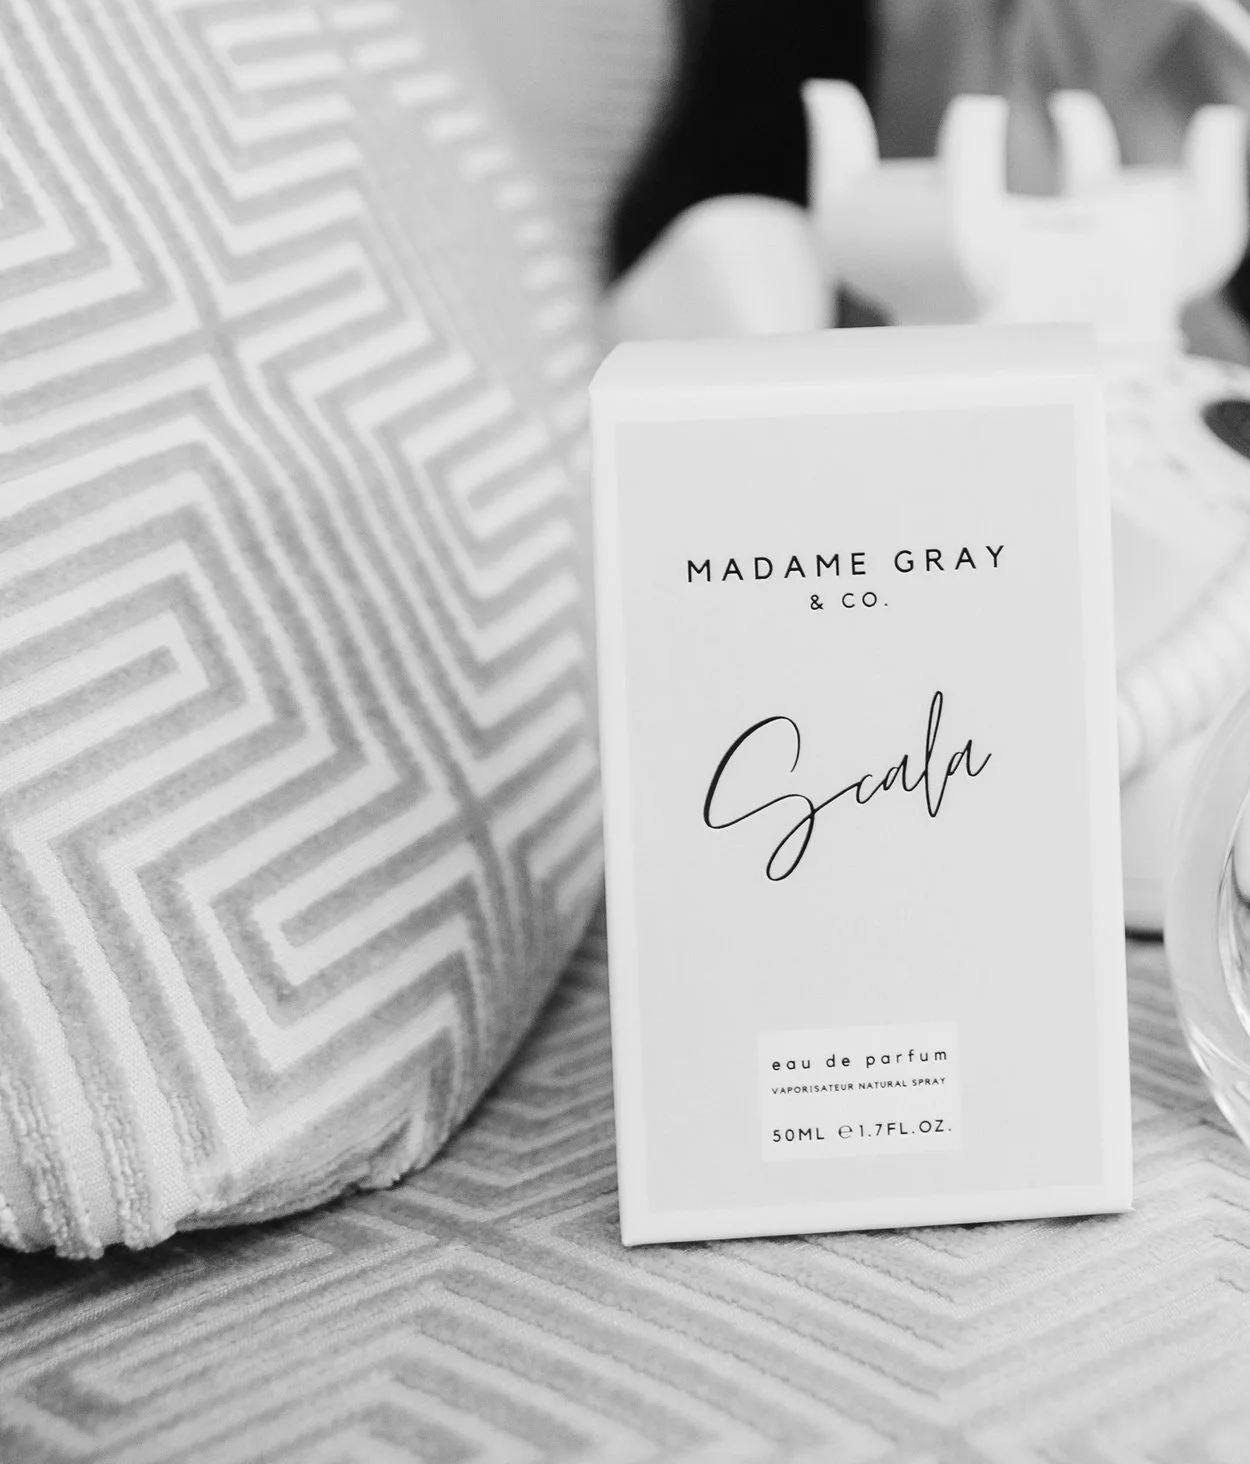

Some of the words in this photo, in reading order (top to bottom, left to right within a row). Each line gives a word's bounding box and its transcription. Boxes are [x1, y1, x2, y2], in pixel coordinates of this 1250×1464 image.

[686, 551, 867, 584] MADAME
[893, 544, 1005, 574] GRAY
[809, 593, 825, 611] &
[841, 591, 889, 609] CO.
[702, 690, 993, 882] Scala
[771, 1059, 812, 1072] eau
[825, 1053, 851, 1069] de
[865, 1048, 948, 1070] parfum
[770, 1082, 854, 1096] VAPORISATEUR
[858, 1079, 908, 1091] NATURAL
[911, 1076, 946, 1088] SPRAY
[772, 1127, 826, 1143] 50ML
